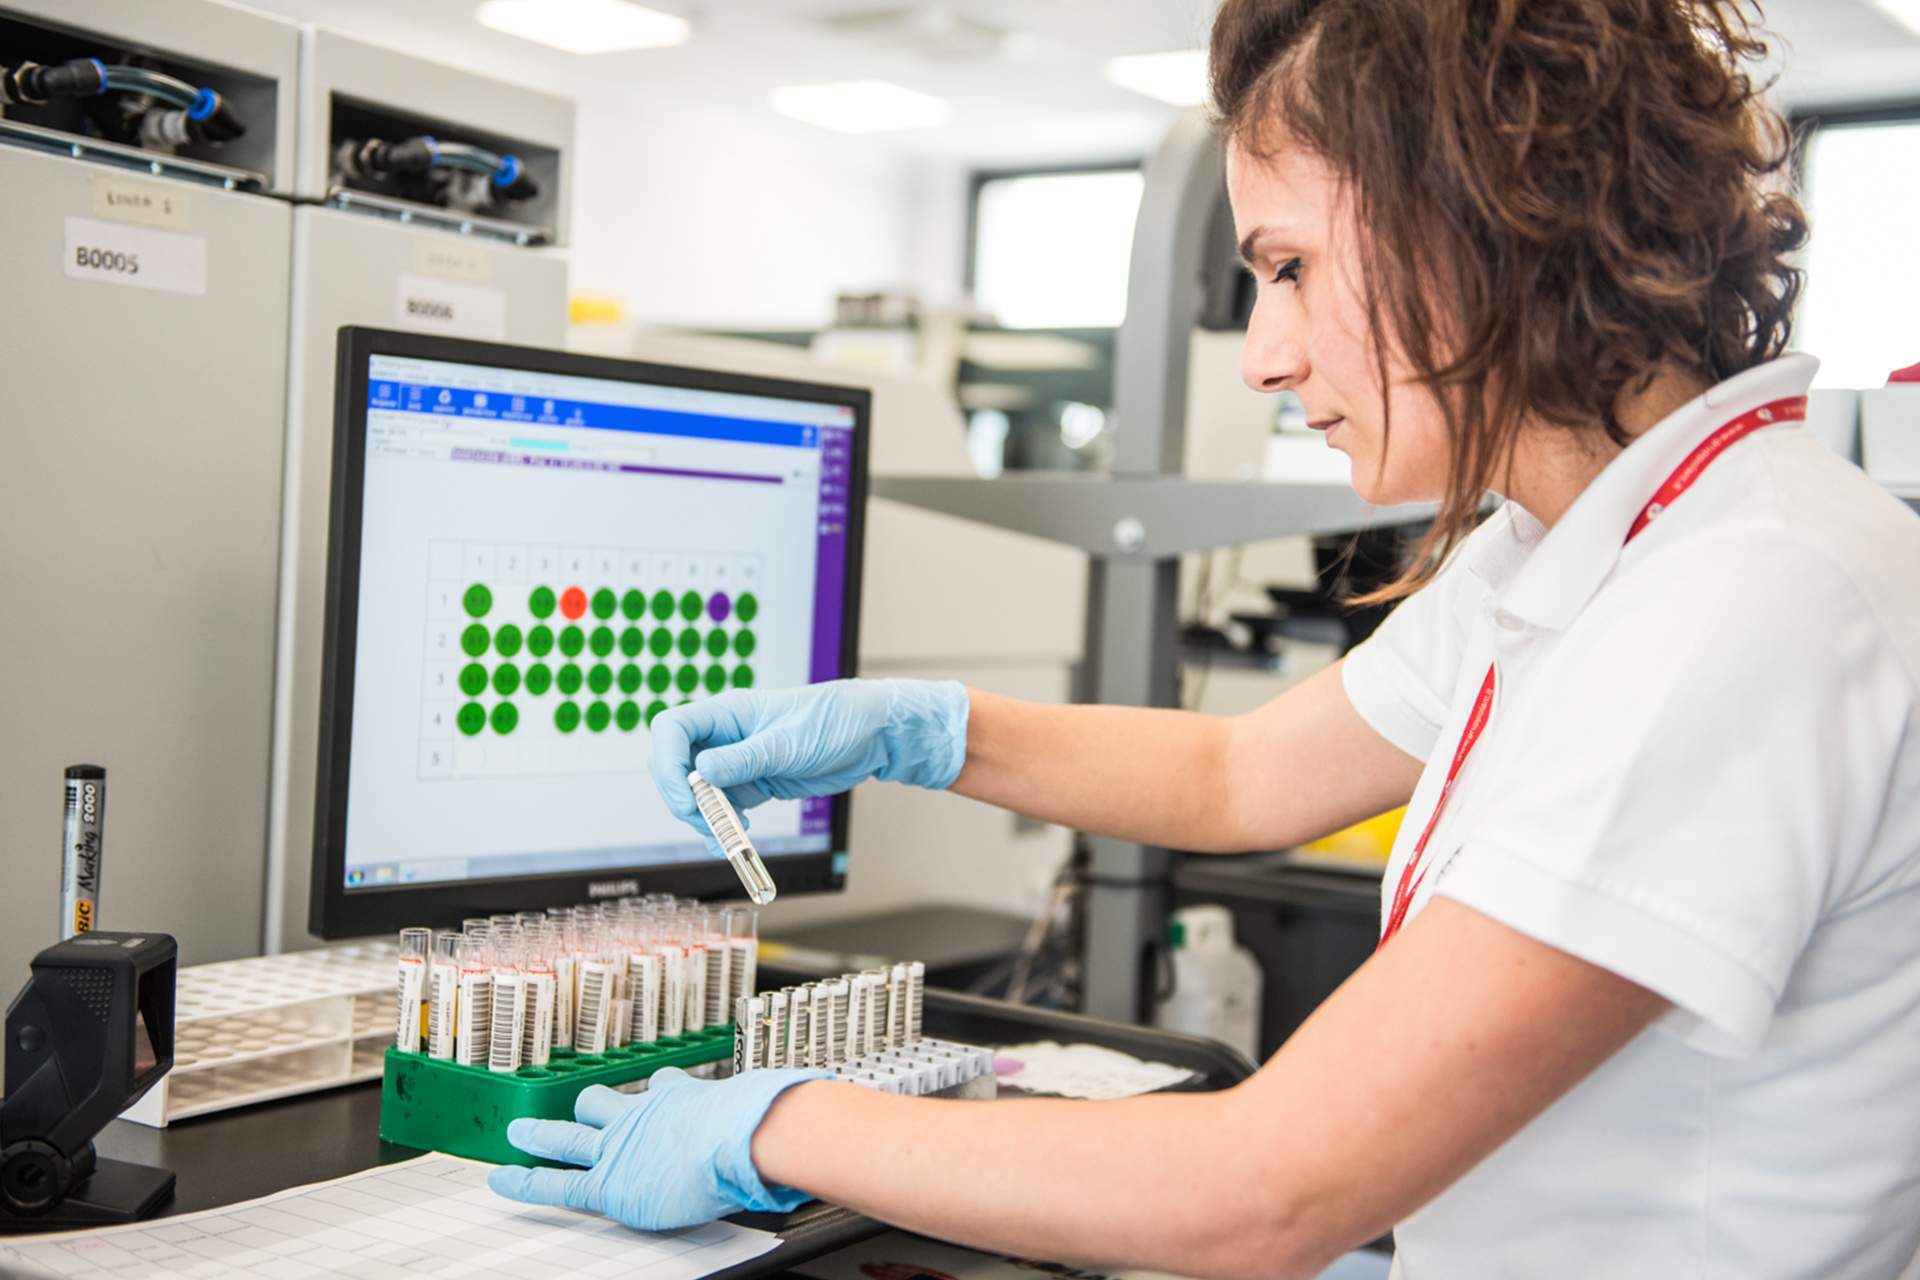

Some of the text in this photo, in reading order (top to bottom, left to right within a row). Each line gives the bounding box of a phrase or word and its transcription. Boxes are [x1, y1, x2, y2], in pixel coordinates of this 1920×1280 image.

[76, 246, 139, 275] B0005
[75, 783, 99, 933] BIC Marking 2000
